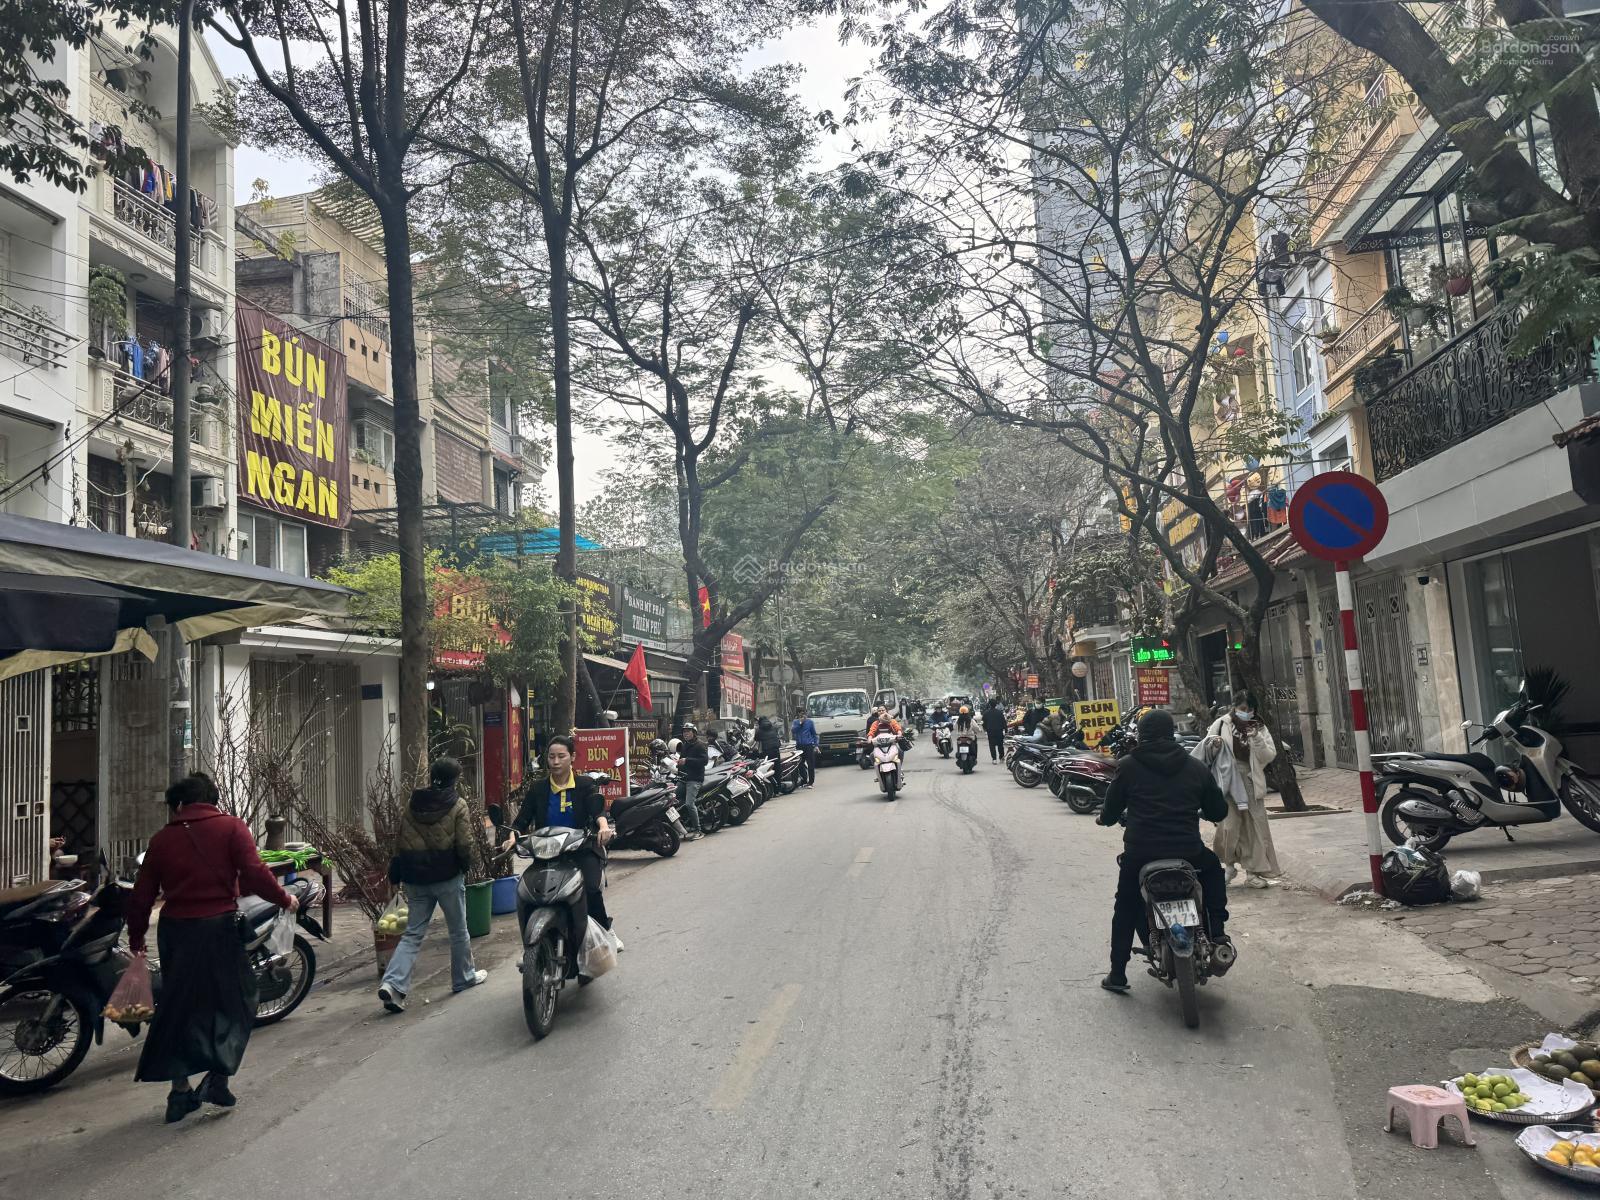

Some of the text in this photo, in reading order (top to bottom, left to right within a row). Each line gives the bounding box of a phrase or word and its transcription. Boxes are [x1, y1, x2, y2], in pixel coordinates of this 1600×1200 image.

[262, 329, 326, 399] BÚN
[251, 390, 334, 463] MIẾN
[247, 451, 338, 519] NGAN
[1080, 702, 1114, 714] BÚN
[587, 744, 609, 761] BÚN
[636, 731, 656, 741] NGAN
